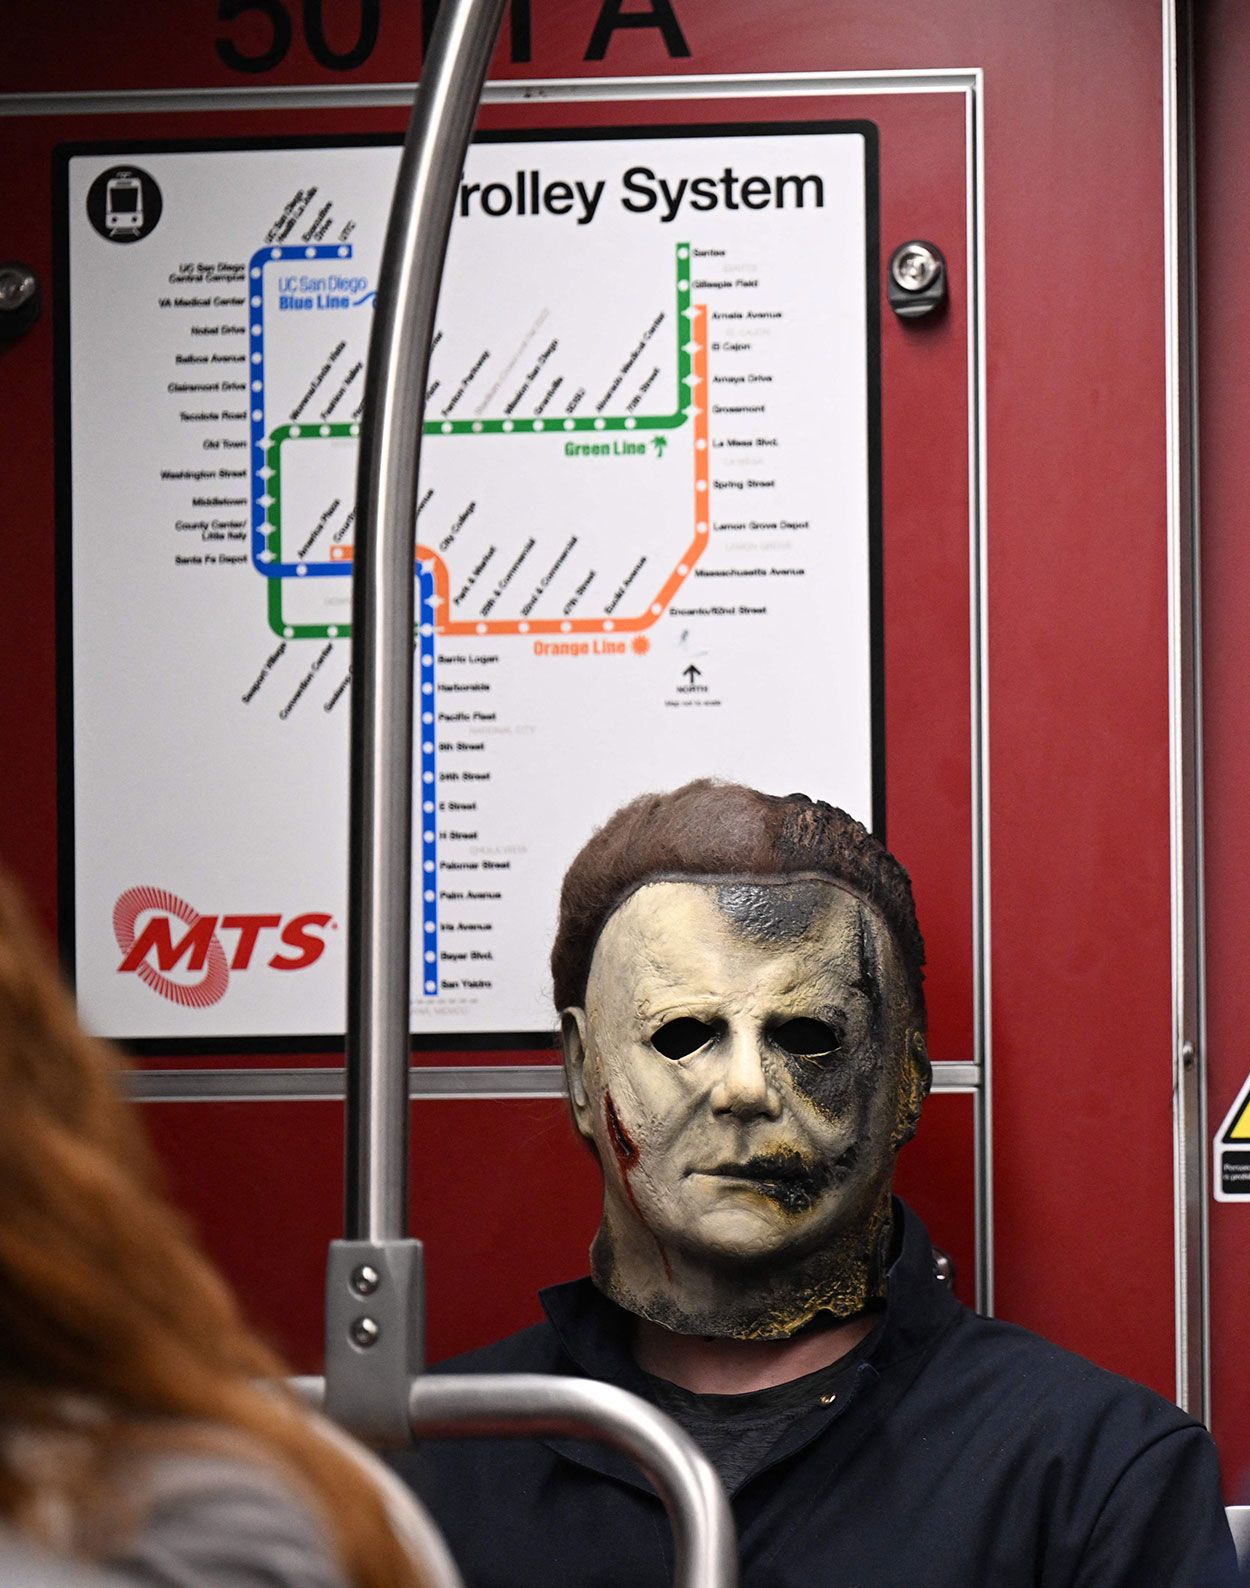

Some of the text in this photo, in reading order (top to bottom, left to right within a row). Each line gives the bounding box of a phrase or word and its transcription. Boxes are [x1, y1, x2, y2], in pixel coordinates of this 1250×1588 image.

[459, 167, 824, 225] rolley System
[278, 276, 367, 293] UC San Diego
[279, 295, 349, 310] Blue Line
[565, 441, 646, 457] Green Line
[534, 639, 626, 656] Orange Line
[116, 913, 333, 972] MTS
